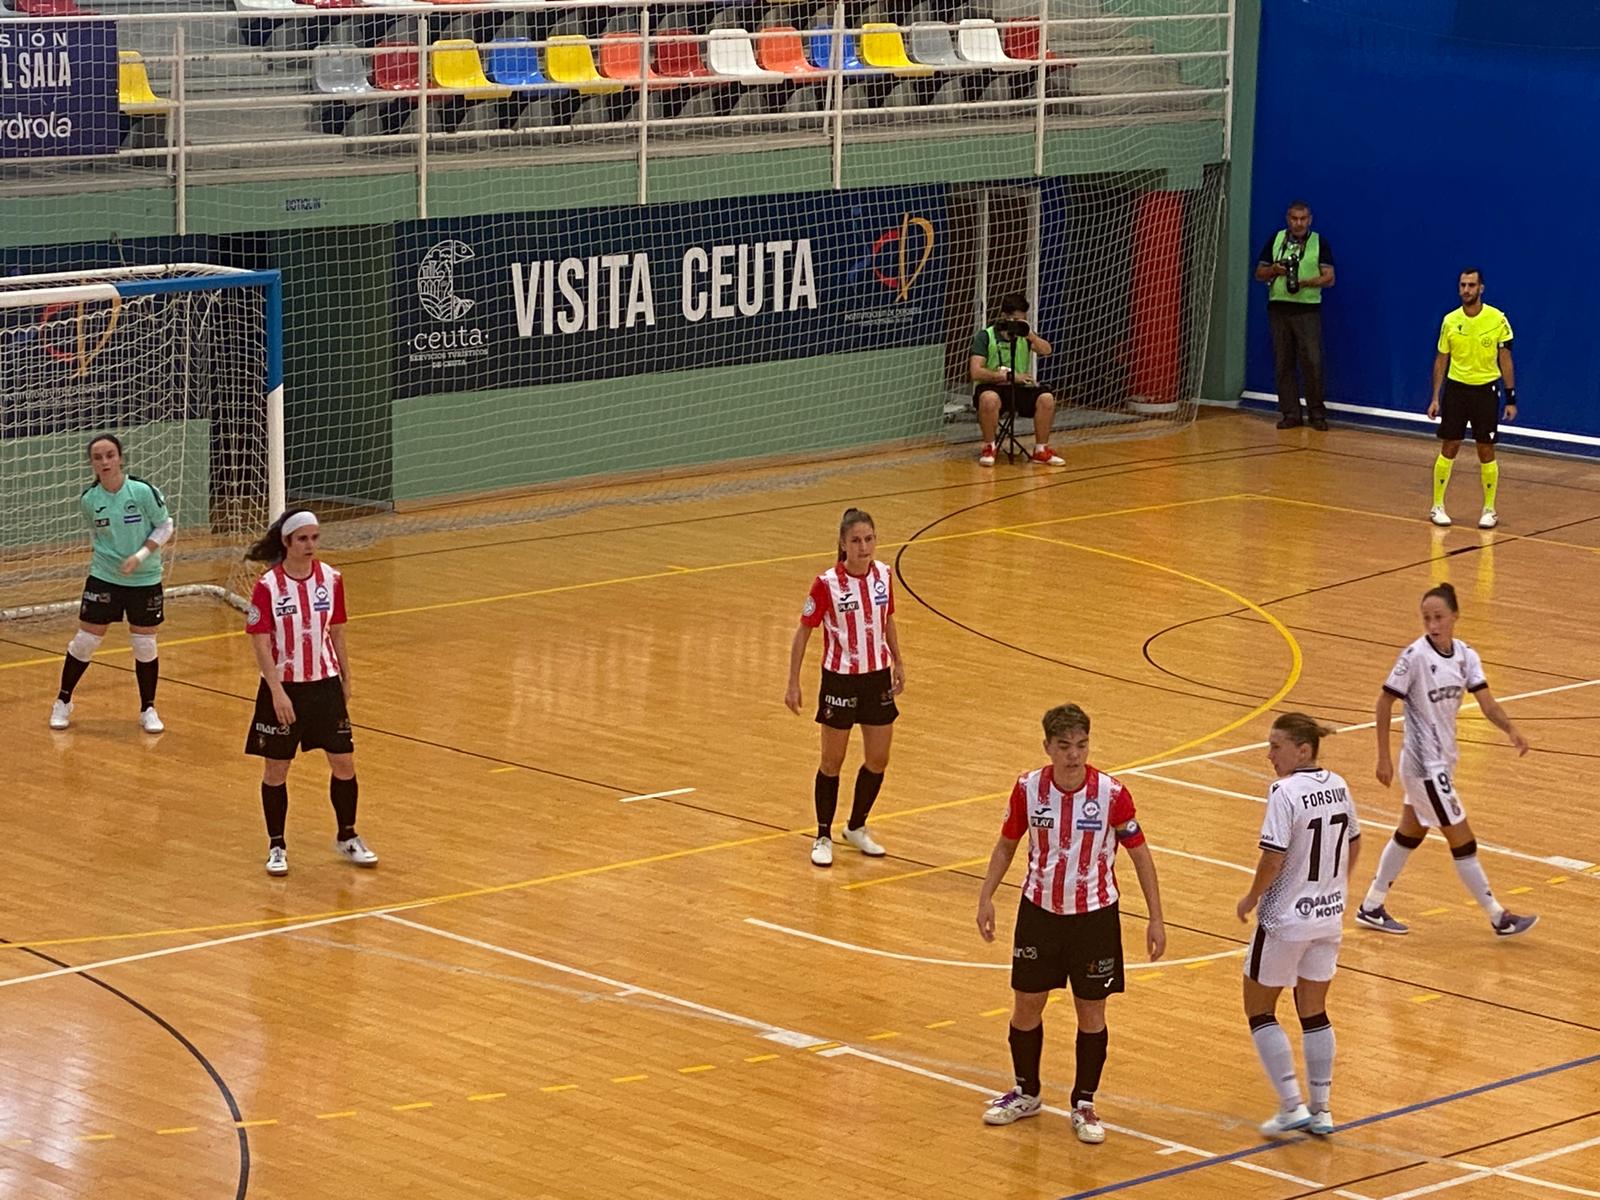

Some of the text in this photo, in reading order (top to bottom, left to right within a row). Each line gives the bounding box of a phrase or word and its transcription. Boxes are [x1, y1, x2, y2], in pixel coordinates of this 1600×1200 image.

[18, 51, 72, 89] SALA
[511, 239, 817, 337] VISITA CEUTA
[1306, 812, 1349, 882] 17
